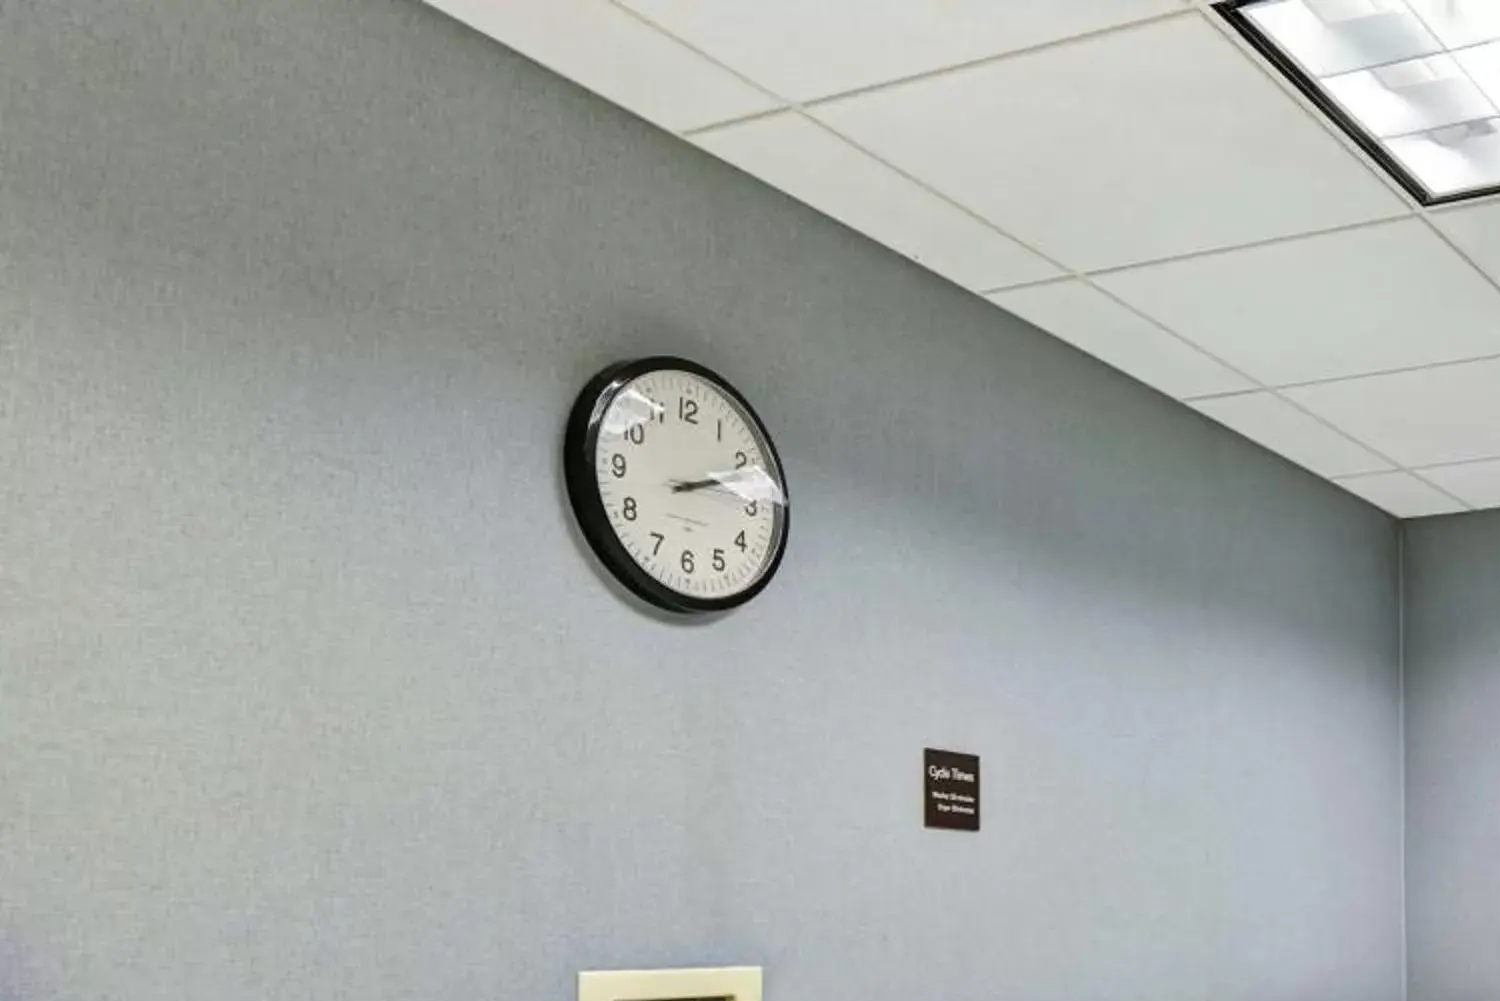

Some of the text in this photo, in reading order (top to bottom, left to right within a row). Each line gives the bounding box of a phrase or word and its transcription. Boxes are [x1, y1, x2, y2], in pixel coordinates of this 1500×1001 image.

[678, 396, 699, 425] 12
[624, 423, 645, 445] 10
[716, 418, 722, 442] 1
[611, 453, 627, 479] 9
[735, 451, 747, 469] 2
[623, 496, 638, 522] 8
[649, 531, 665, 555] 7
[734, 529, 748, 553] 4
[680, 550, 695, 574] 6
[711, 548, 726, 572] 5
